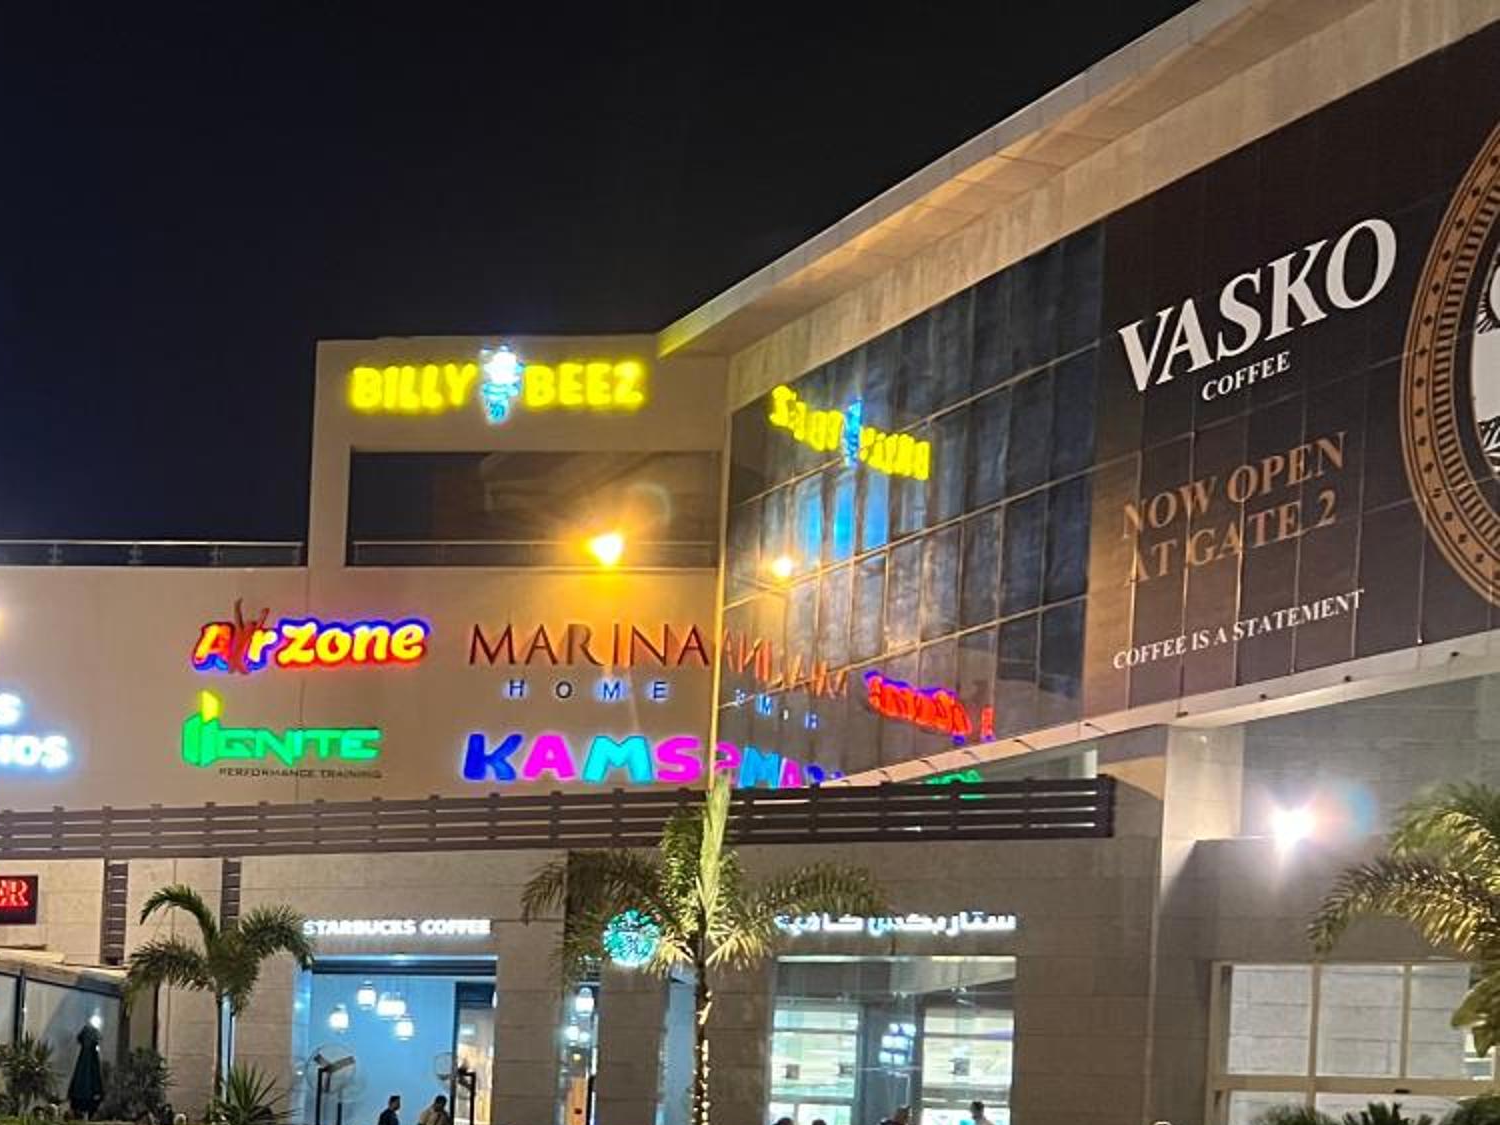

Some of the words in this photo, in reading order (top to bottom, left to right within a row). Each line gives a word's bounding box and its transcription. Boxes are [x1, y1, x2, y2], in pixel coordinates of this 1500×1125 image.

[1118, 218, 1397, 392] VASKO
[350, 363, 476, 410] BILLY
[523, 360, 644, 408] BEEZ
[1201, 352, 1290, 402] COFFEE
[1123, 476, 1217, 539] NOW
[1227, 430, 1348, 503] OPEN
[1124, 540, 1178, 587] AT
[1187, 501, 1302, 567] GATE
[1316, 489, 1337, 528] 2
[469, 623, 711, 667] MARINA
[1113, 635, 1188, 669] COFFEE
[1192, 629, 1210, 651] IS
[1214, 627, 1228, 645] A
[1233, 589, 1365, 641] STATEMENT
[219, 767, 316, 779] PERFORMANCE
[321, 768, 383, 779] TRAINING
[303, 918, 417, 936] STARBUCKS
[419, 918, 492, 935] COFFEE
[867, 911, 1017, 937] ستاربكس
